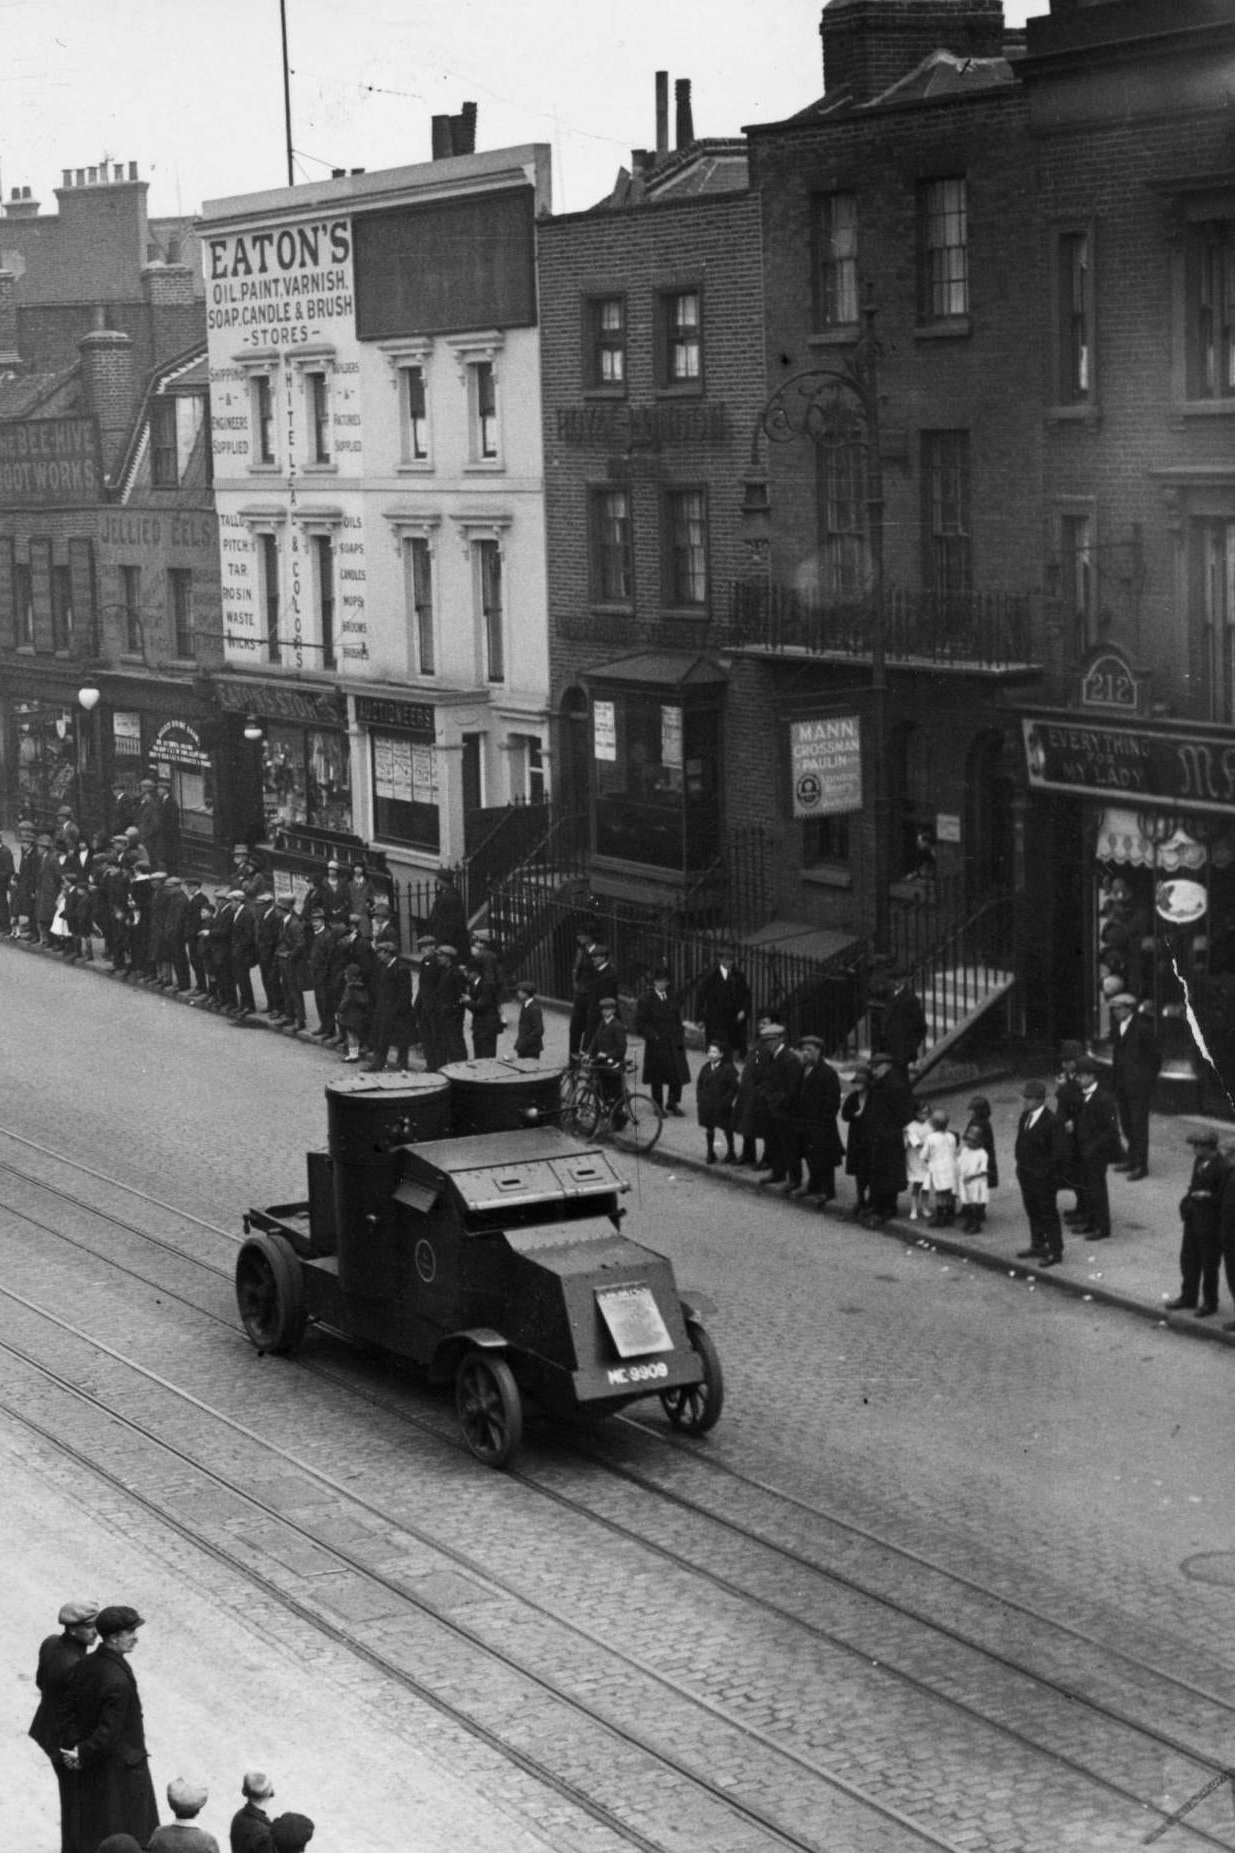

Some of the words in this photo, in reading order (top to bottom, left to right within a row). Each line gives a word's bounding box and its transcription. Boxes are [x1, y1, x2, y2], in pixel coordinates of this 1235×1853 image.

[209, 220, 351, 281] EATON'S
[242, 302, 292, 326] CANDLE
[295, 301, 304, 321] &
[307, 295, 353, 320] BRUSH
[211, 415, 249, 430] ENGINEERS
[213, 439, 249, 455] SUPPLIED
[334, 439, 363, 452] SUPPLIED
[32, 458, 95, 490] WORKS
[343, 516, 362, 528] OILS
[102, 514, 161, 545] JELLIED
[170, 518, 213, 547] EELS
[339, 542, 365, 555] SOAPS
[228, 563, 248, 577] TAR
[339, 568, 366, 581] CANDLES
[343, 595, 365, 608] MOPS
[226, 611, 255, 626] WASTE
[341, 621, 367, 634] BROOMS
[227, 634, 256, 651] WICKS
[1091, 673, 1129, 702] 212
[799, 720, 854, 741] MANN
[793, 738, 860, 758] CROSSMAN
[1048, 727, 1150, 758] EVERYTHING
[802, 754, 847, 771] PAULIN
[1087, 752, 1115, 765] FOR
[1062, 761, 1086, 779] MY
[1094, 764, 1144, 787] LADY
